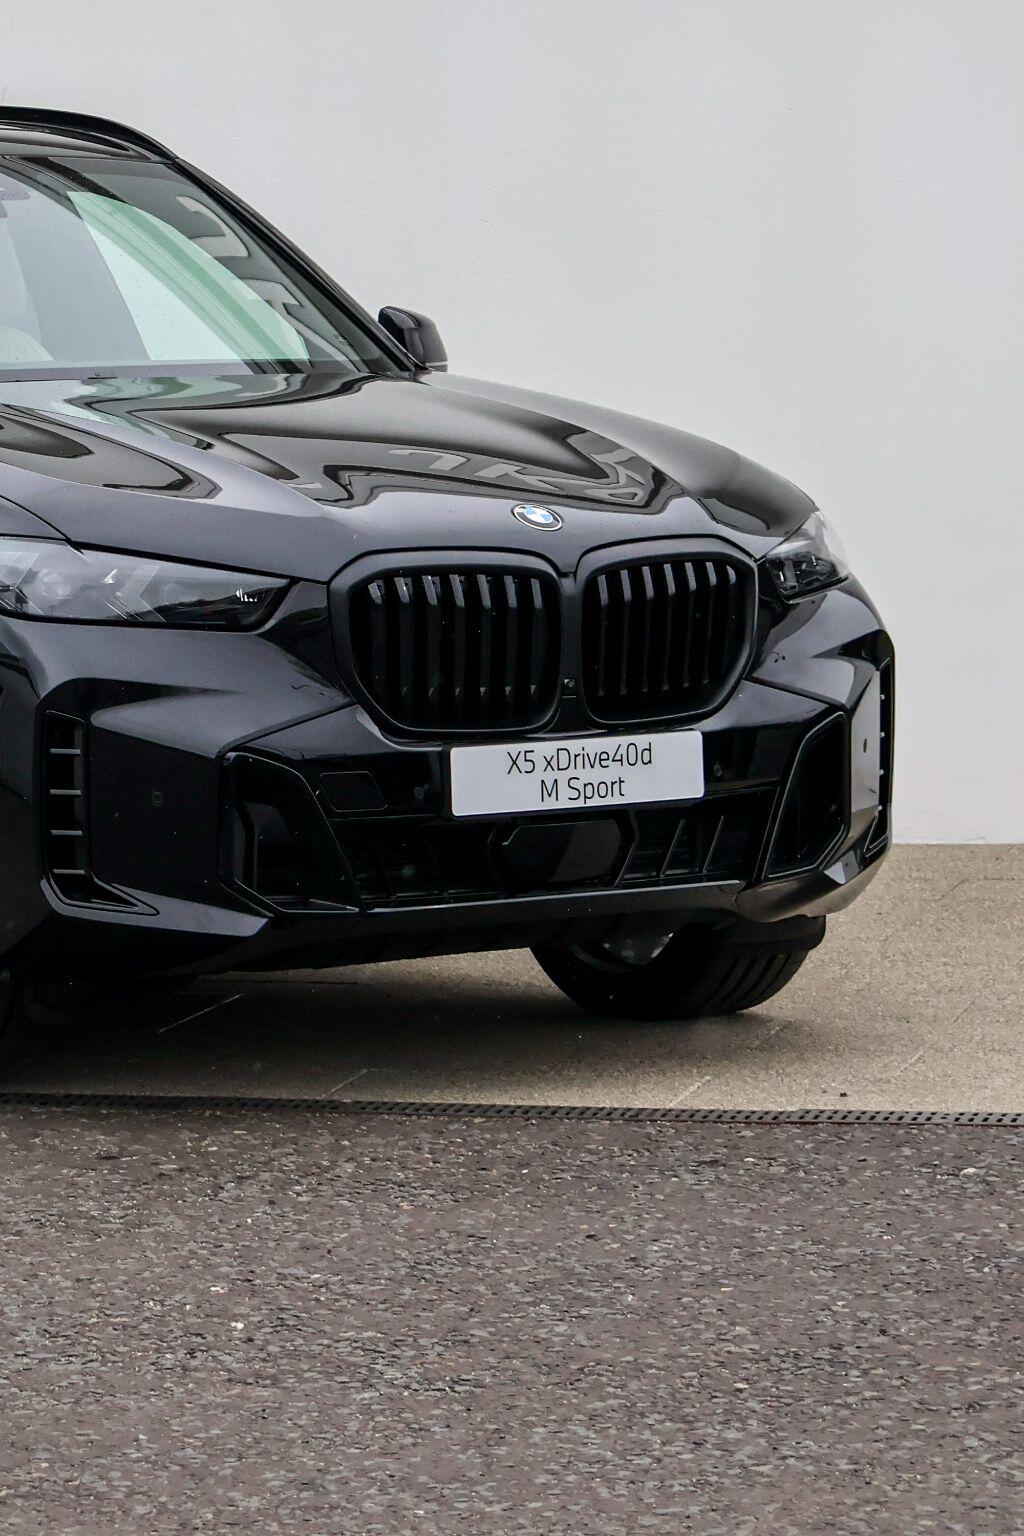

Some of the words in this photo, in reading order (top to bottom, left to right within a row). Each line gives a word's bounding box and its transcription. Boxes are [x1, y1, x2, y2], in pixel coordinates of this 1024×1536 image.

[507, 749, 535, 775] X5
[543, 742, 653, 773] xDrive40d
[540, 778, 559, 802] M
[567, 776, 626, 804] Sport
